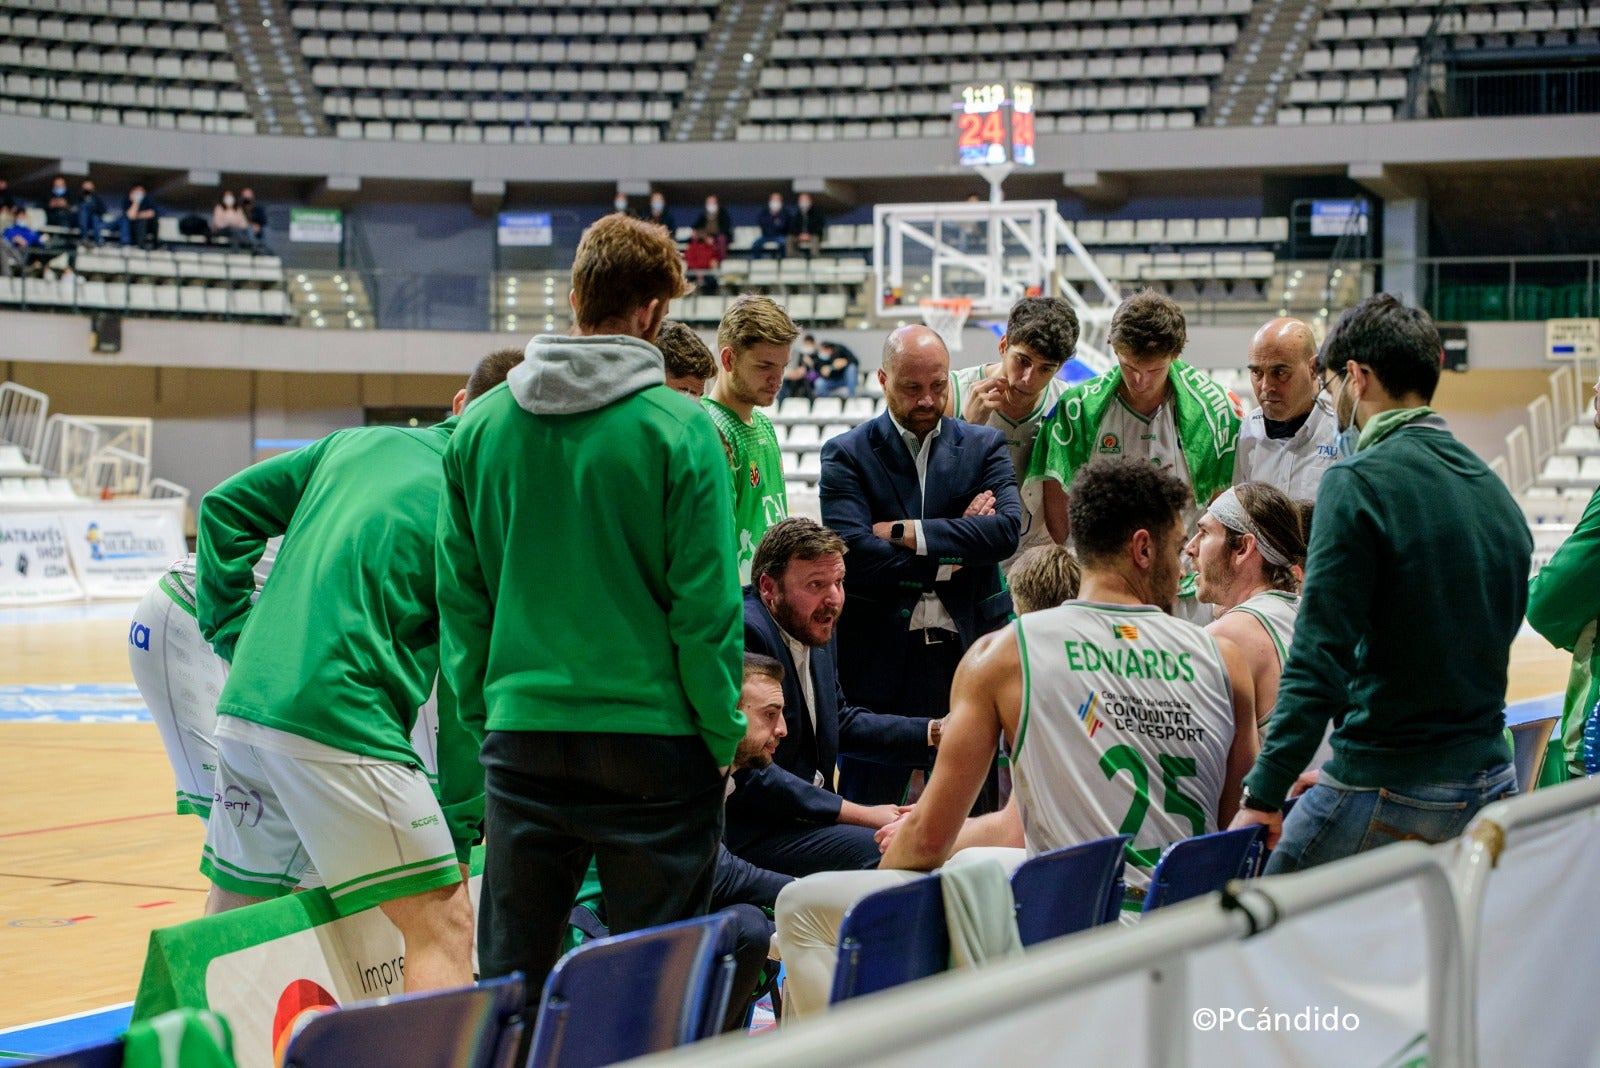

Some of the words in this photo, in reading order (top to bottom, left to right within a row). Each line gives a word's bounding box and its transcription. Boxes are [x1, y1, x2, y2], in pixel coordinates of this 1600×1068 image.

[959, 111, 1006, 146] 24
[1316, 445, 1338, 457] TAU
[1064, 640, 1195, 683] EDWARDS
[1105, 702, 1191, 726] COMUNITAT
[1115, 718, 1134, 732] DE
[1098, 744, 1206, 868] 25
